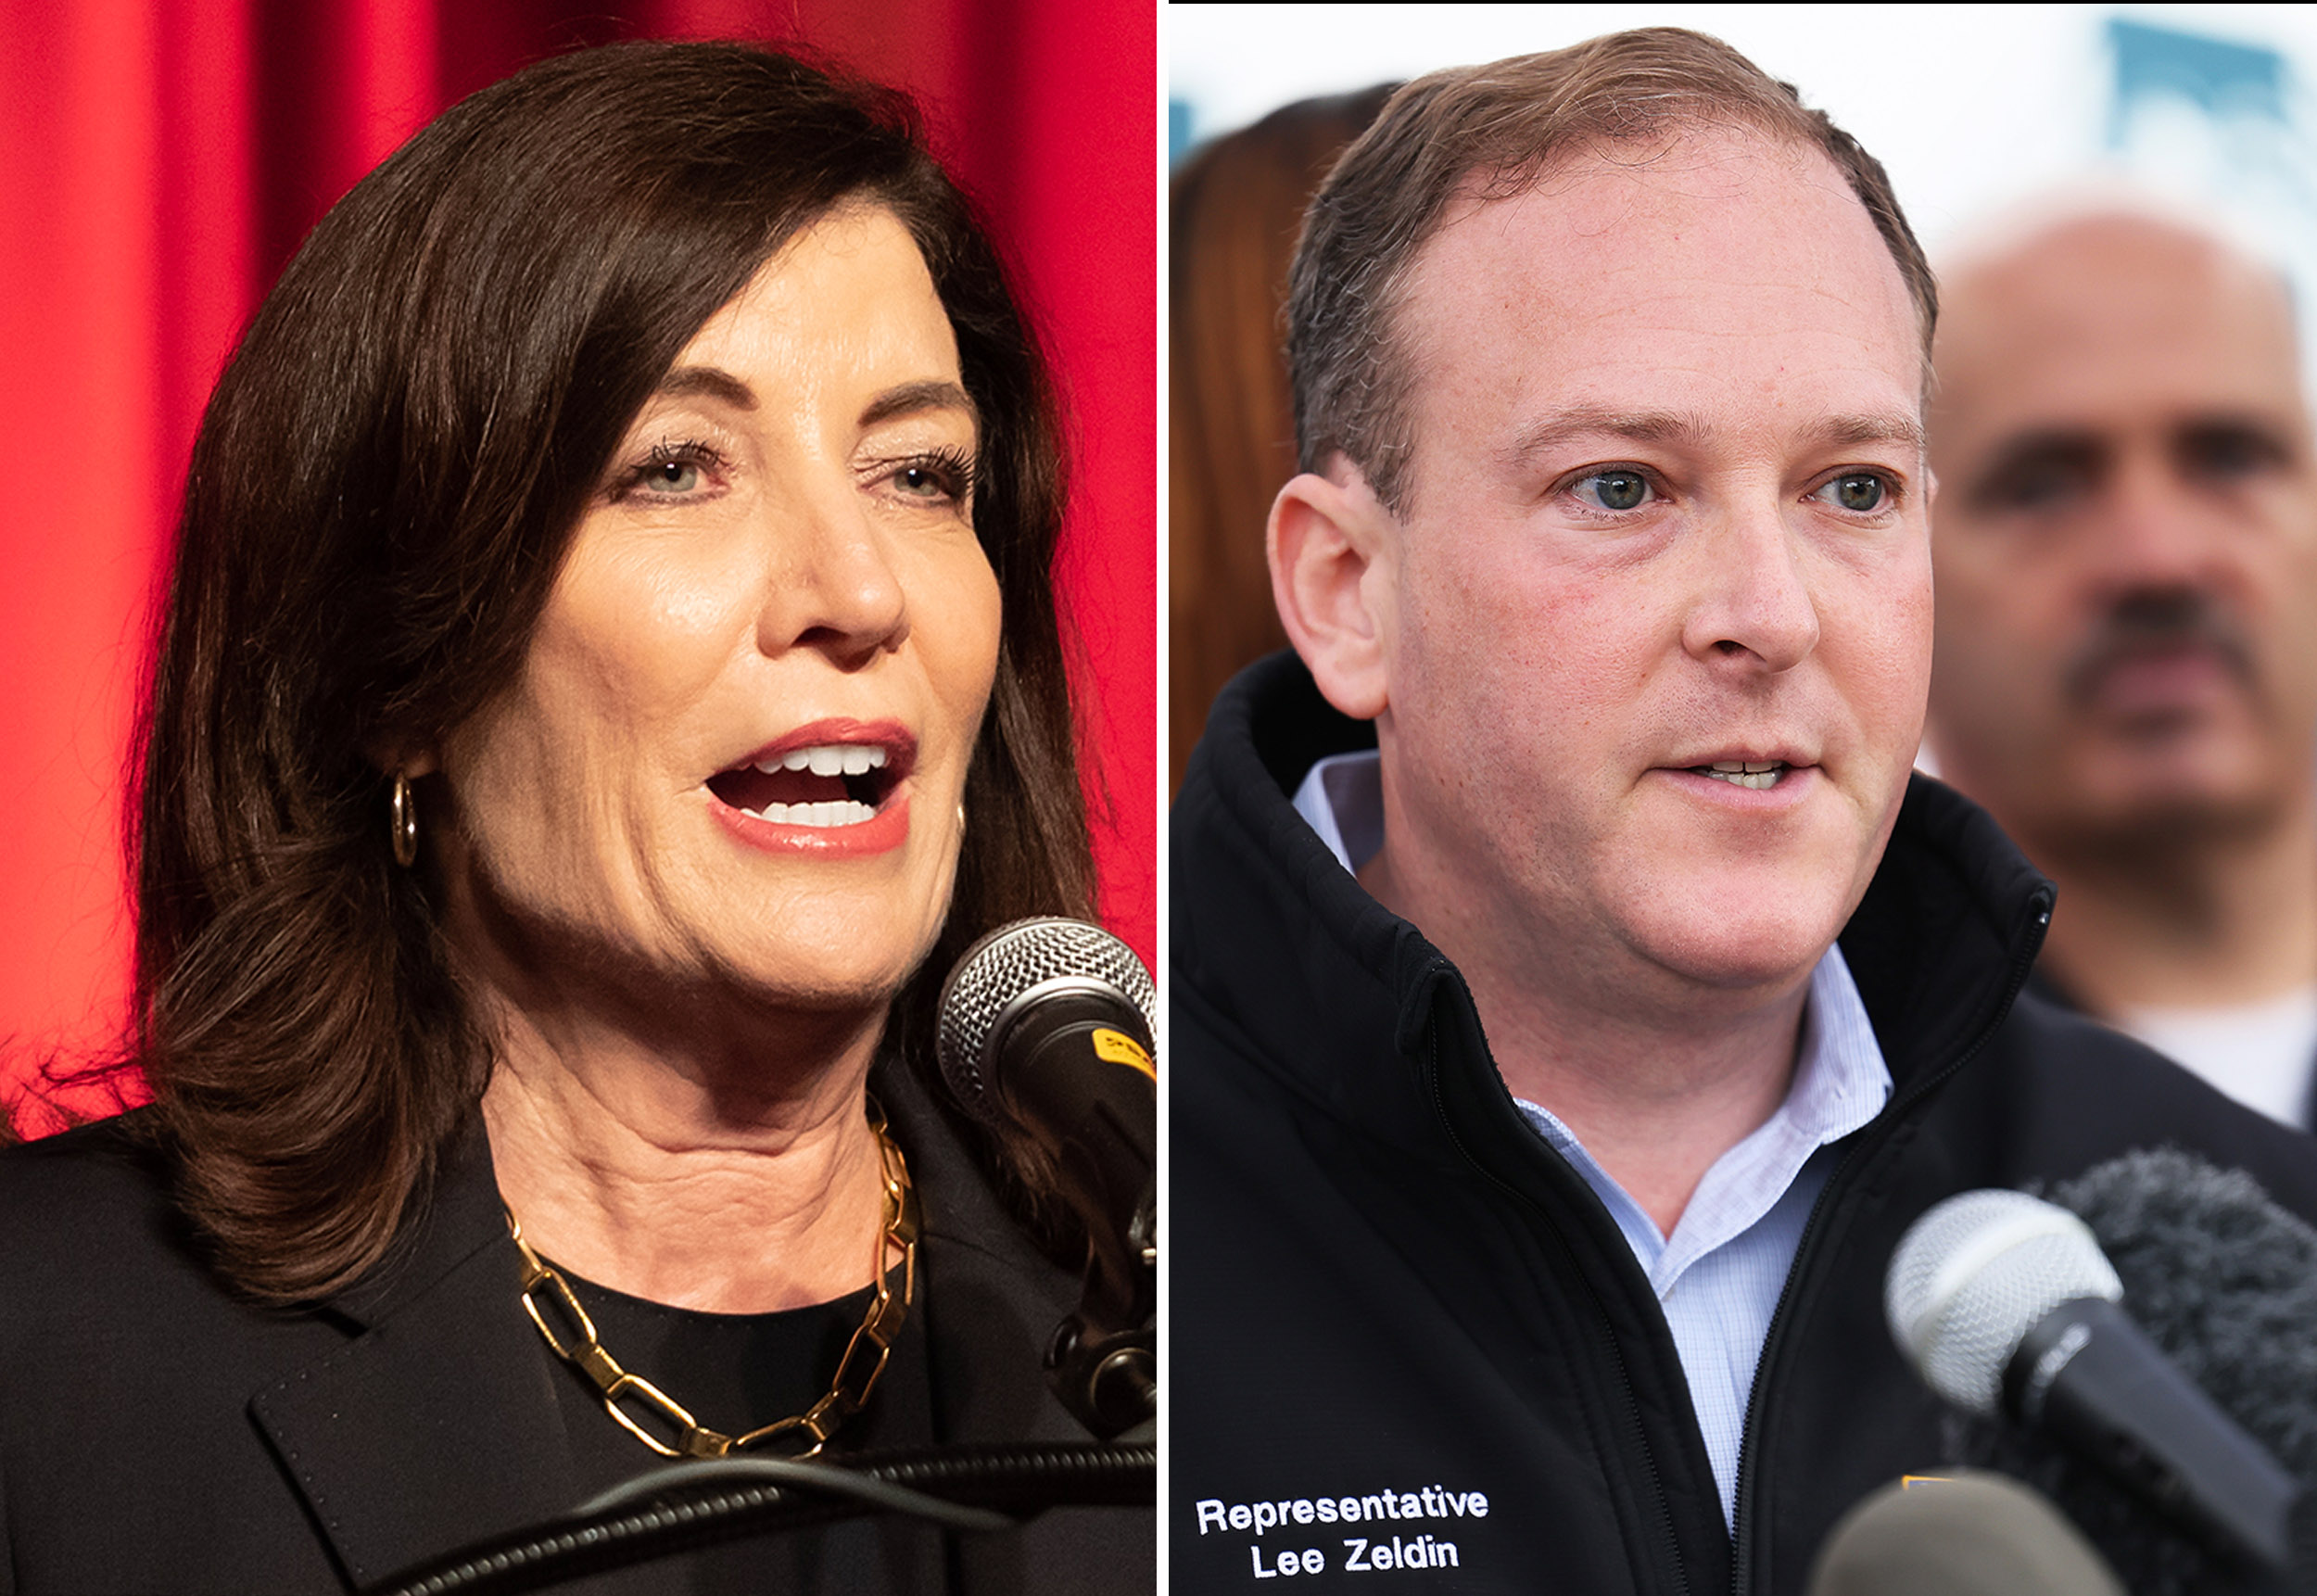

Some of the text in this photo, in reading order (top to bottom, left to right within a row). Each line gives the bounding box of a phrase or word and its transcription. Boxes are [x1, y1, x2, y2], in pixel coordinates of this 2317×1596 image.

[1196, 1485, 1488, 1535] Representative
[1250, 1535, 1460, 1578] Lee Zeldin
